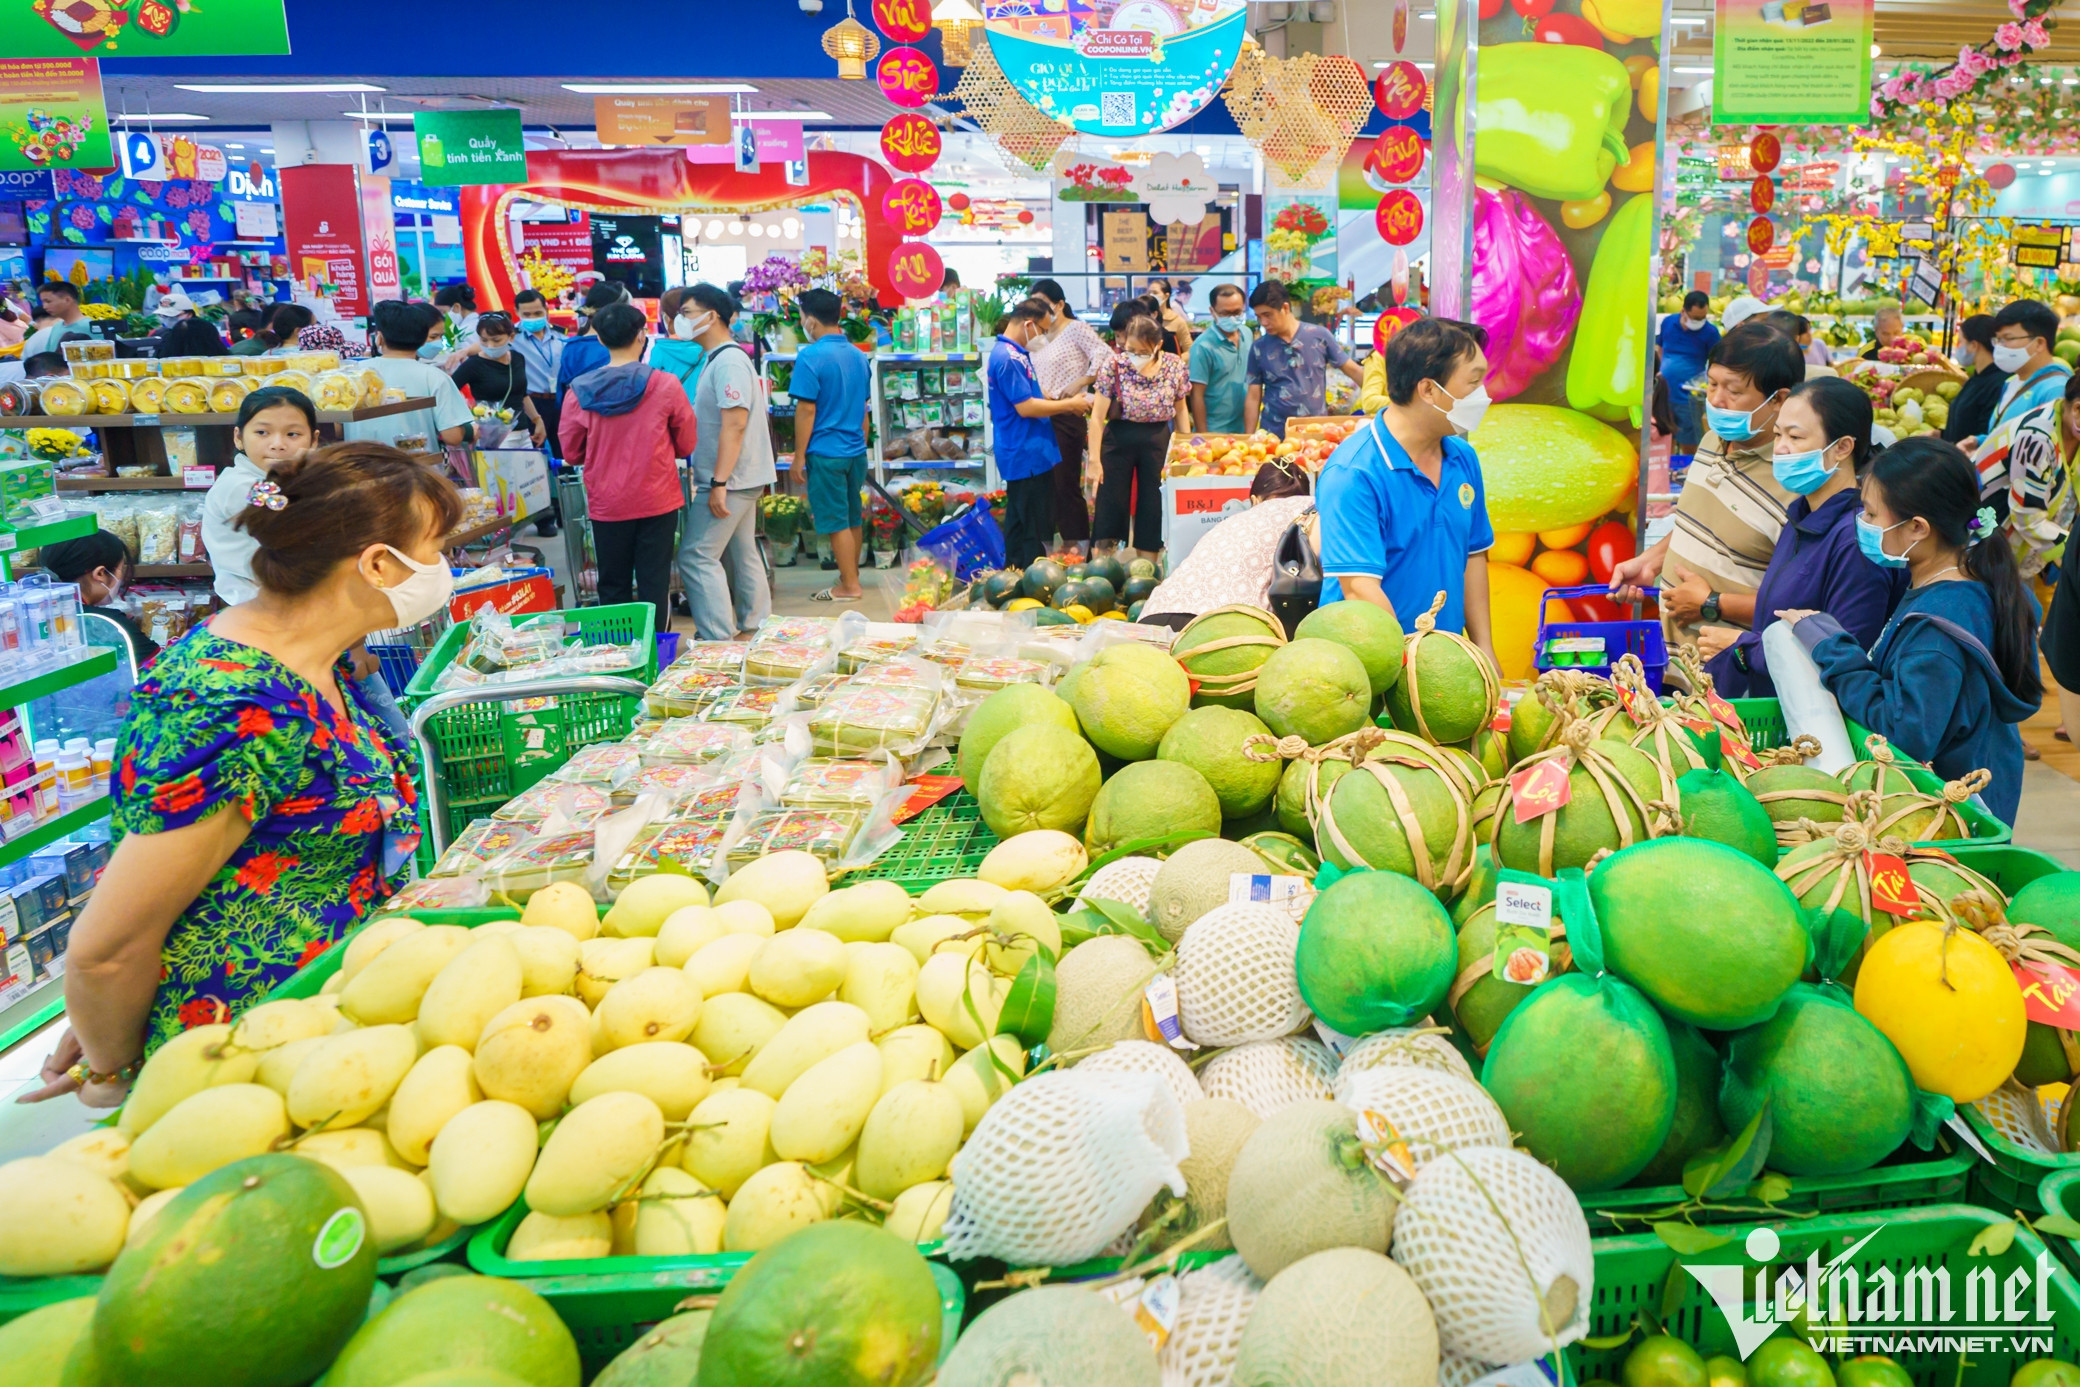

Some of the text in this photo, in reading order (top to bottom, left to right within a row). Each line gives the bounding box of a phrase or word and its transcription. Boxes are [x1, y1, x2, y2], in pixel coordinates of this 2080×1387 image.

[1114, 34, 1127, 44] Có
[375, 139, 388, 161] 3
[469, 135, 497, 150] Quầy
[135, 142, 151, 164] 4
[447, 152, 468, 163] tính
[471, 150, 492, 163] tiền
[373, 253, 392, 268] GÓI
[373, 269, 396, 284] QUÀ
[1521, 768, 1558, 804] Lộc
[1873, 869, 1906, 901] Tài
[1506, 896, 1542, 912] Select
[2022, 978, 2077, 1013] Tài
